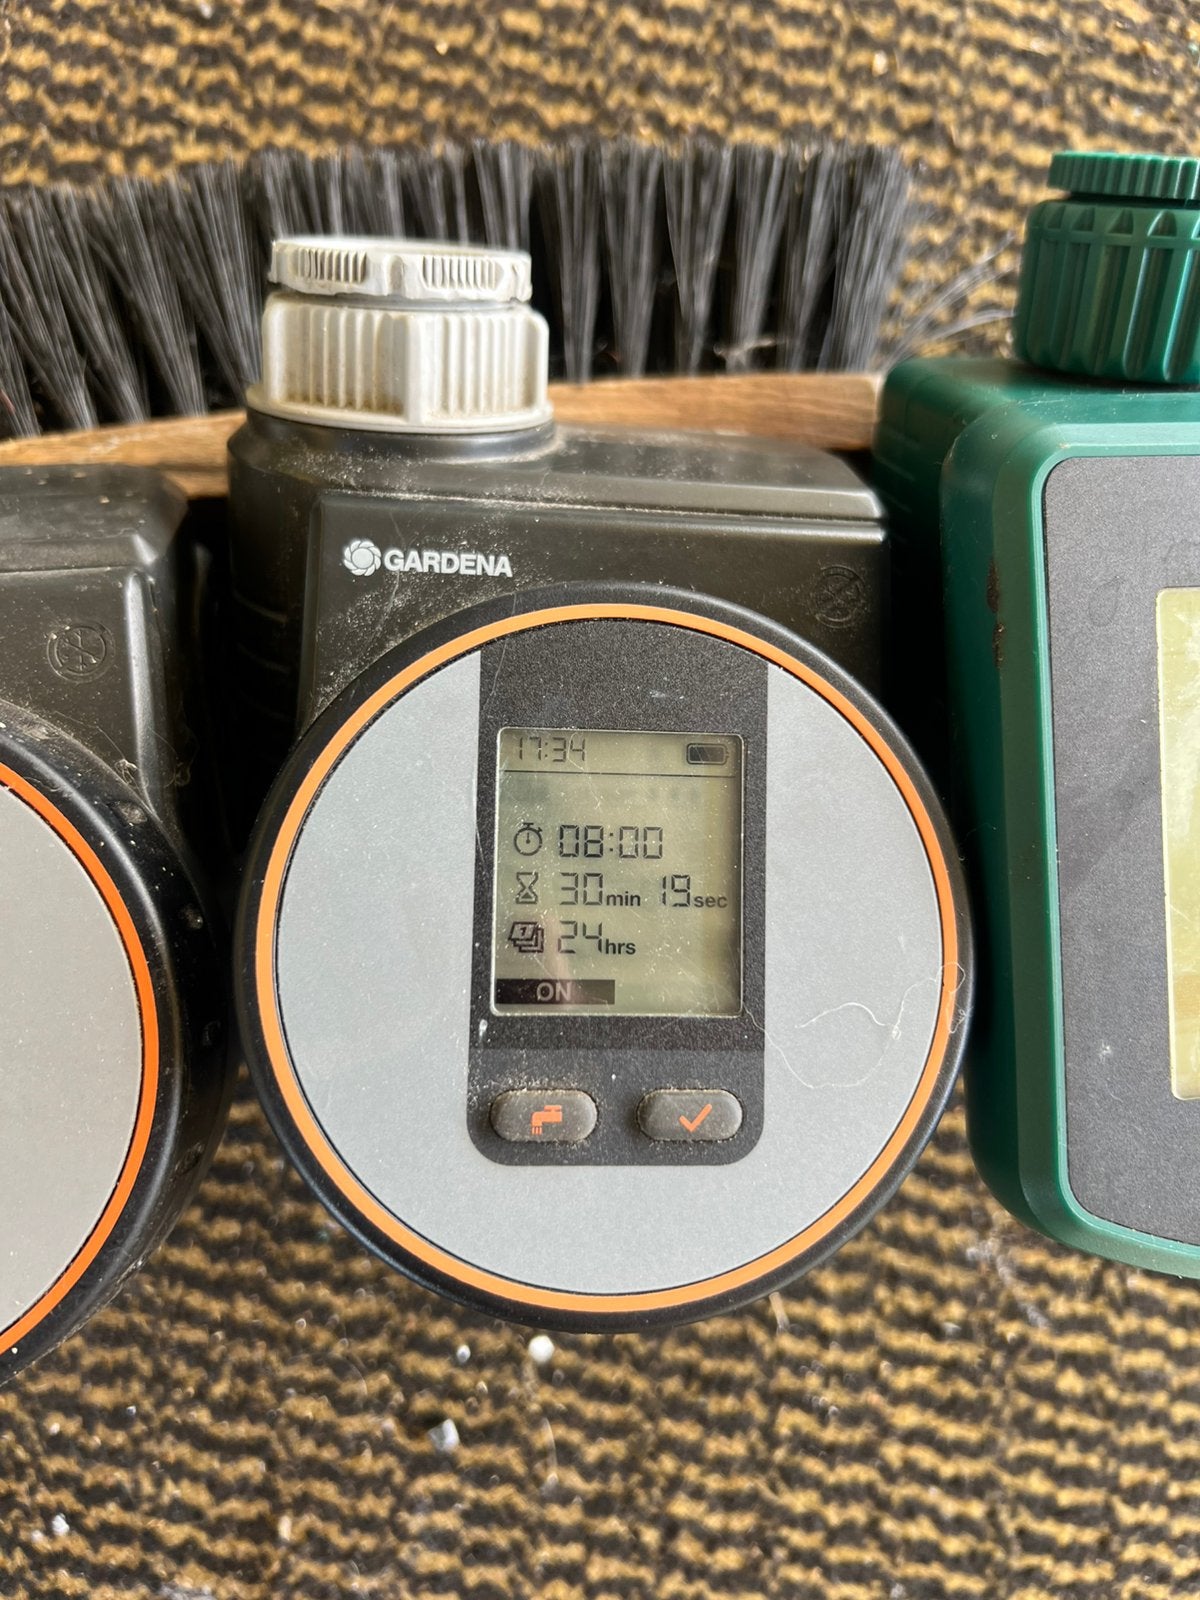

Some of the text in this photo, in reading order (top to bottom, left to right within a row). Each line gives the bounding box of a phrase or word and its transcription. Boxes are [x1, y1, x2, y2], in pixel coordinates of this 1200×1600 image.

[384, 550, 513, 577] GARDENA
[517, 736, 586, 762] 17:34
[559, 824, 663, 859] 08:00
[536, 982, 572, 1001] ON
